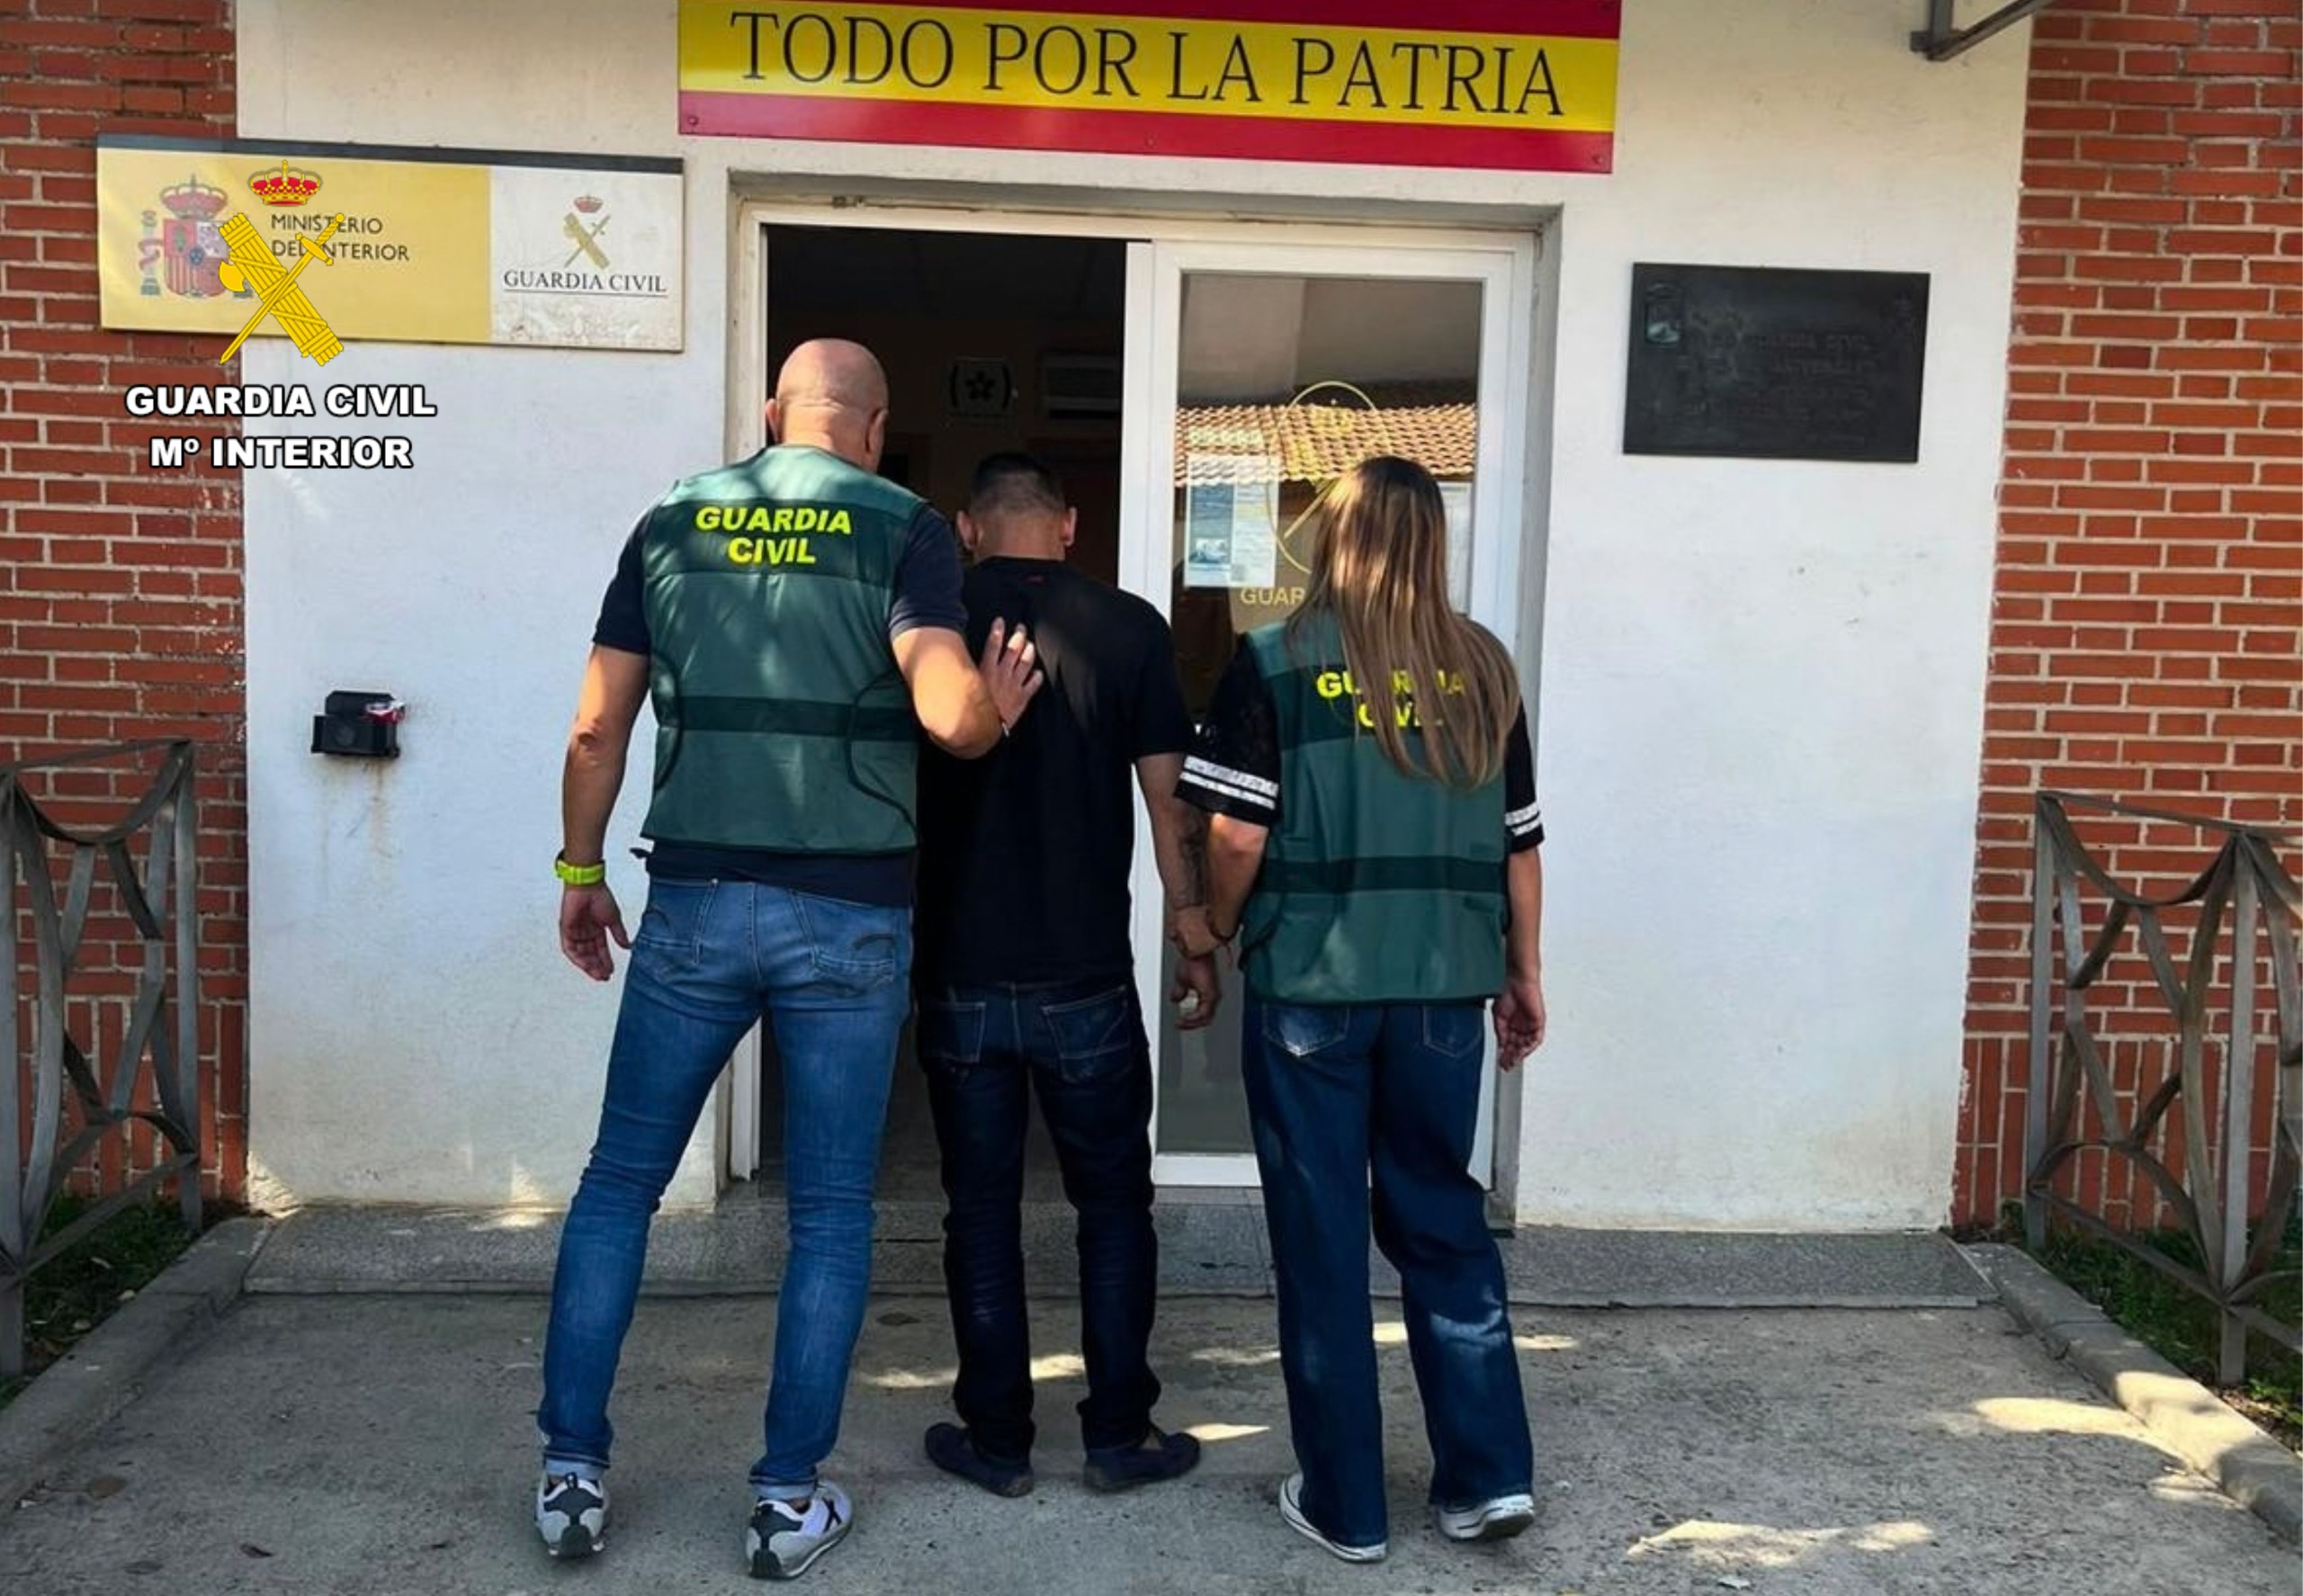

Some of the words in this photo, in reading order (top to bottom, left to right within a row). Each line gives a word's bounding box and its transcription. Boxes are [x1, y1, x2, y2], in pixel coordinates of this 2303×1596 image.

[730, 12, 954, 87] TODO
[983, 22, 1140, 96] POR
[1167, 32, 1262, 102] LA
[1289, 38, 1564, 115] PATRIA
[271, 214, 383, 235] MINISTERIO
[272, 240, 305, 257] DEL
[318, 242, 409, 261] NTERIOR
[504, 270, 603, 290] GUARDIA
[609, 274, 668, 292] CIVIL
[695, 506, 852, 534] GUARDIA
[728, 537, 816, 564] CIVIL
